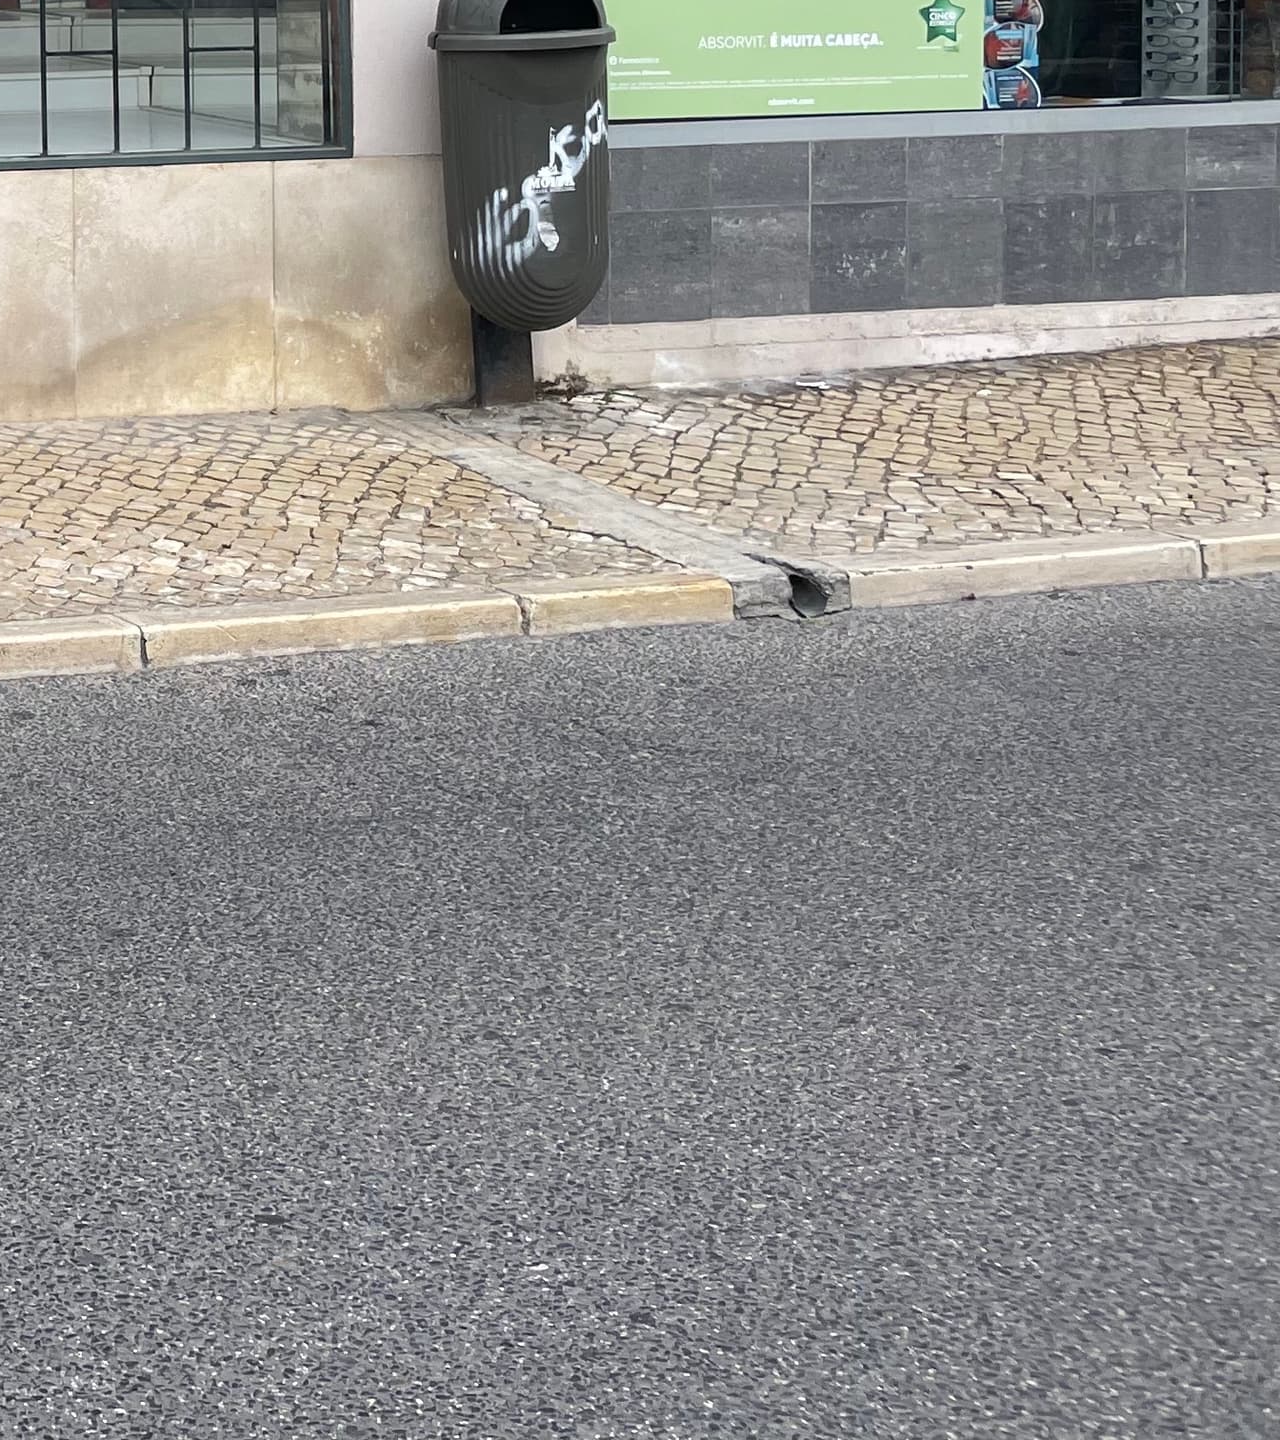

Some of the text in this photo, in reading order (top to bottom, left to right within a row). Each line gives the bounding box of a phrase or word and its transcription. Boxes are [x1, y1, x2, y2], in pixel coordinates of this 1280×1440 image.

[698, 32, 884, 50] ABSORVIT. É MUITA CABEÇA.
